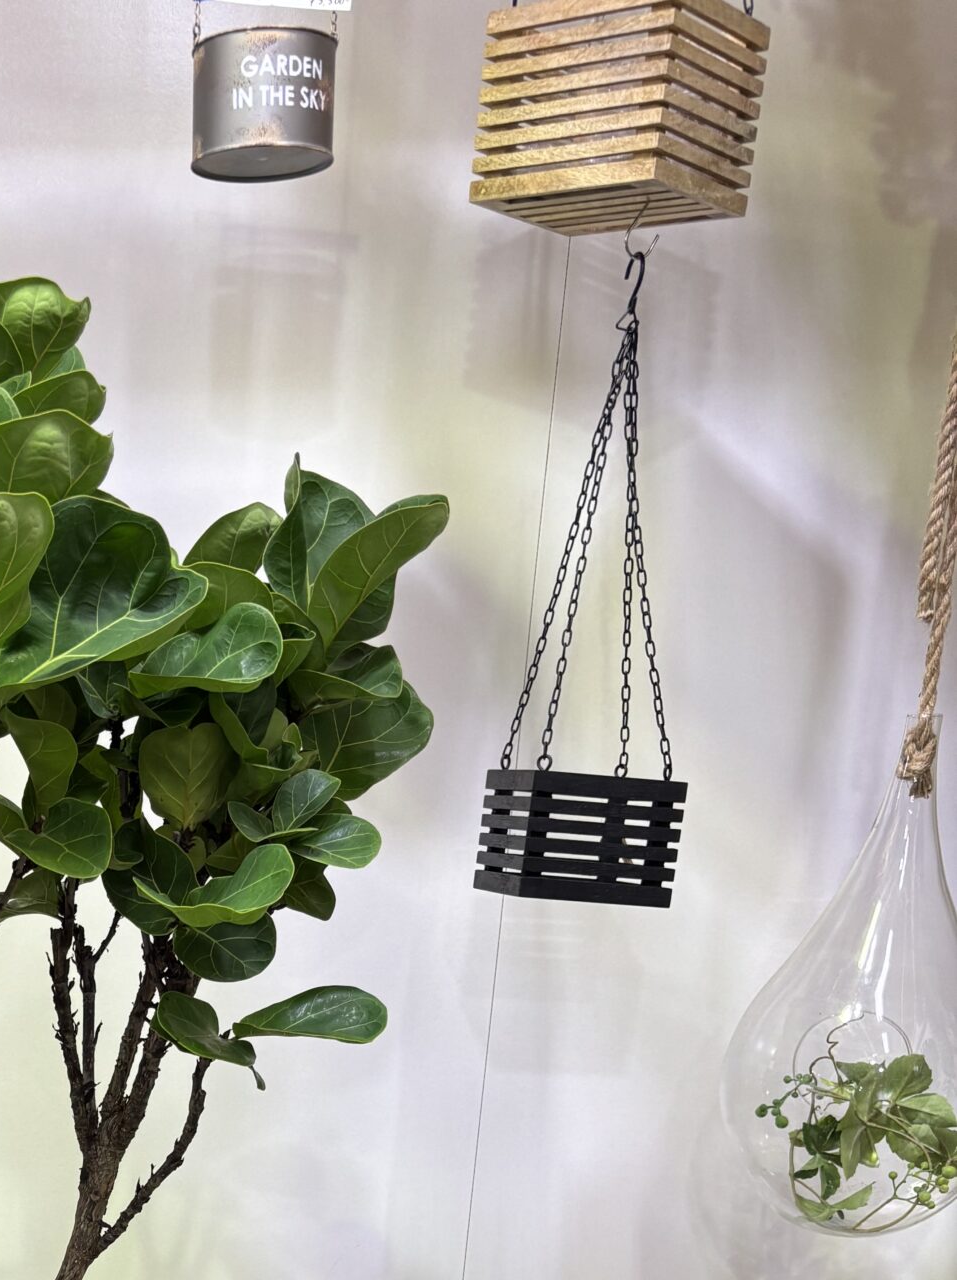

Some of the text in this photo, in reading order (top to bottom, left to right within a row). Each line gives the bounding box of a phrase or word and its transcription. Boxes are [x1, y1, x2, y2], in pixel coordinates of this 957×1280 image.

[241, 54, 322, 80] GARDEN
[232, 85, 327, 111] IN THE SKY
